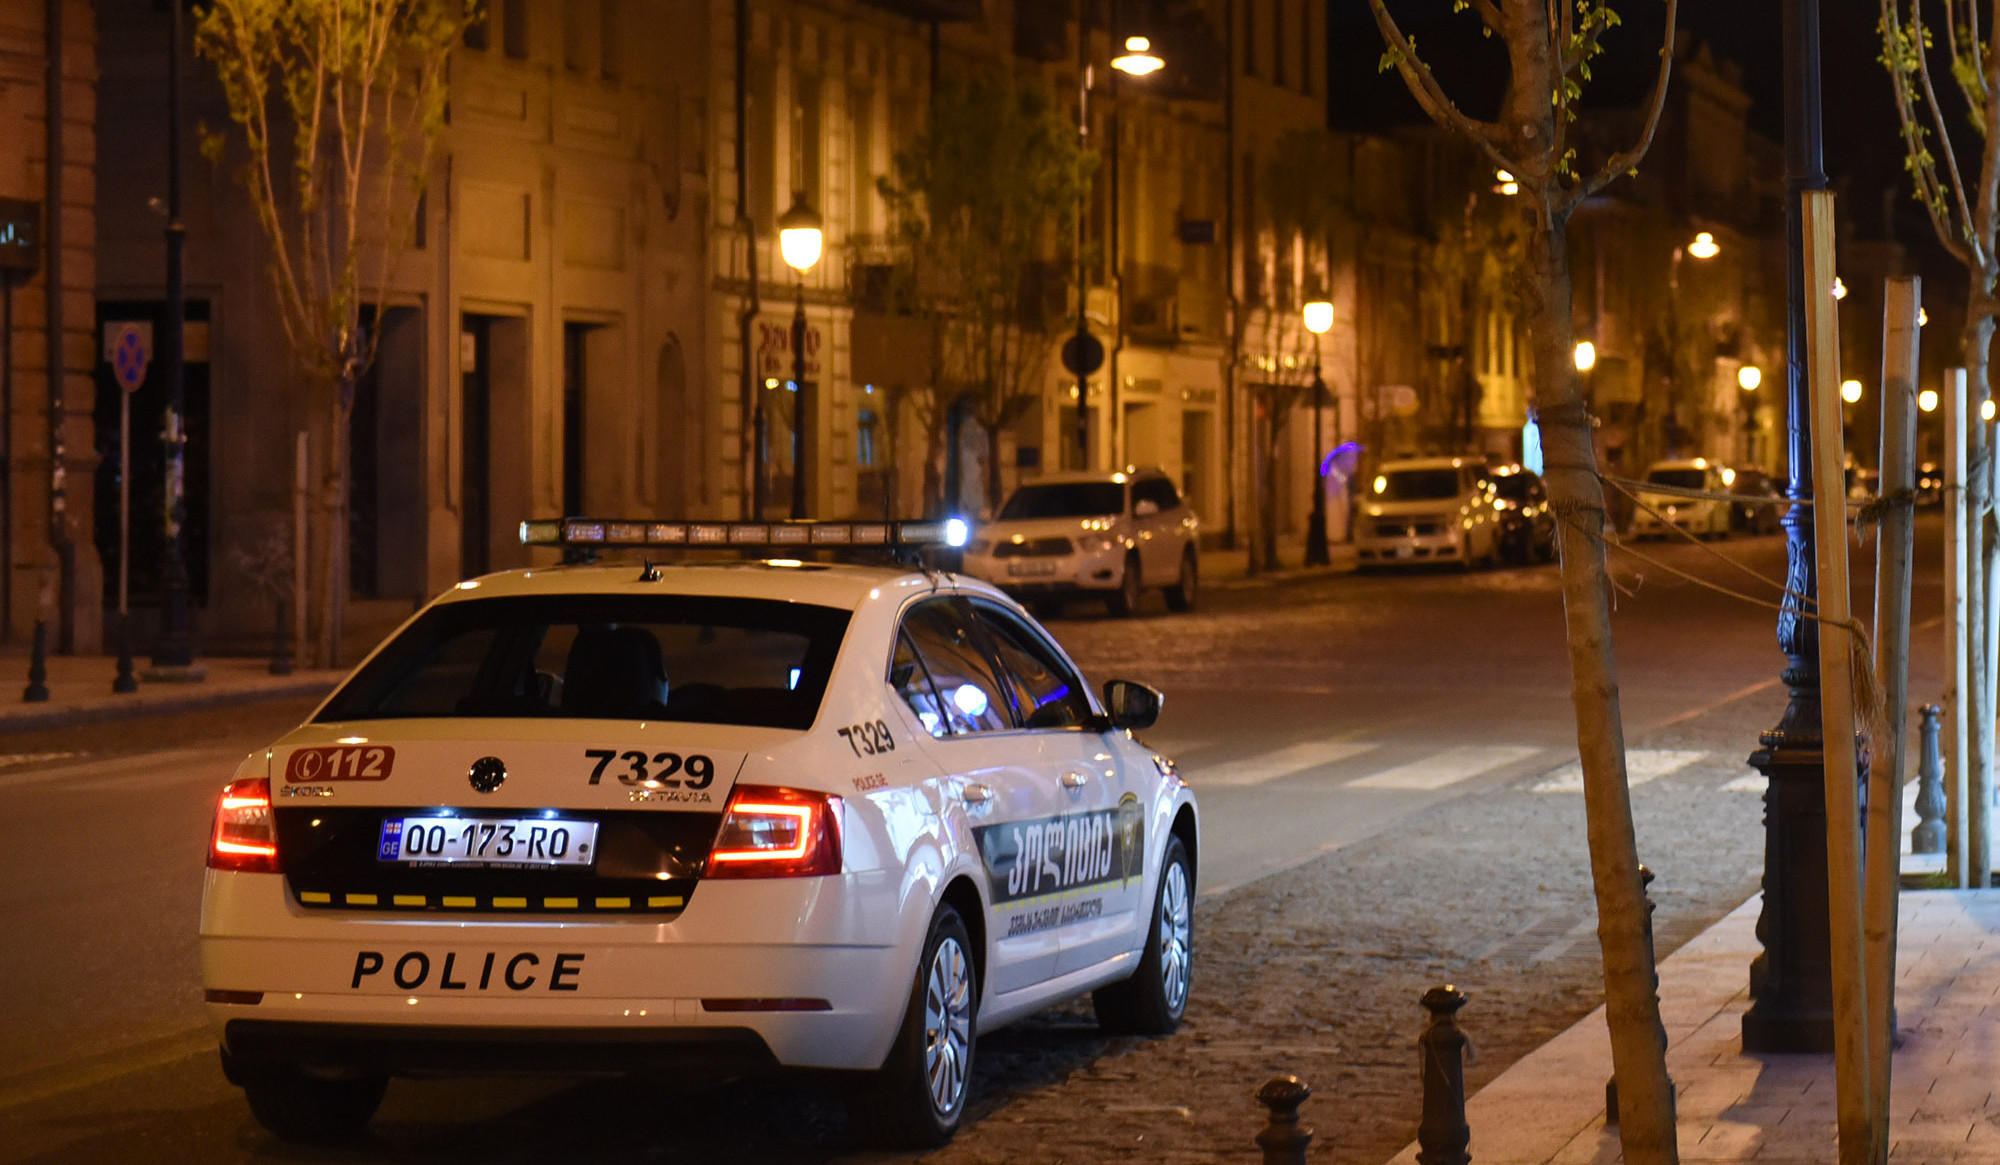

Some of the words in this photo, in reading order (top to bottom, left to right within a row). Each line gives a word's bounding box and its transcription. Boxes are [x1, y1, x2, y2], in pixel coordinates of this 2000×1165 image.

[837, 718, 895, 758] 7329
[327, 748, 385, 777] 112
[585, 749, 715, 790] 7329
[382, 841, 399, 855] GE
[351, 951, 585, 991] POLICE
